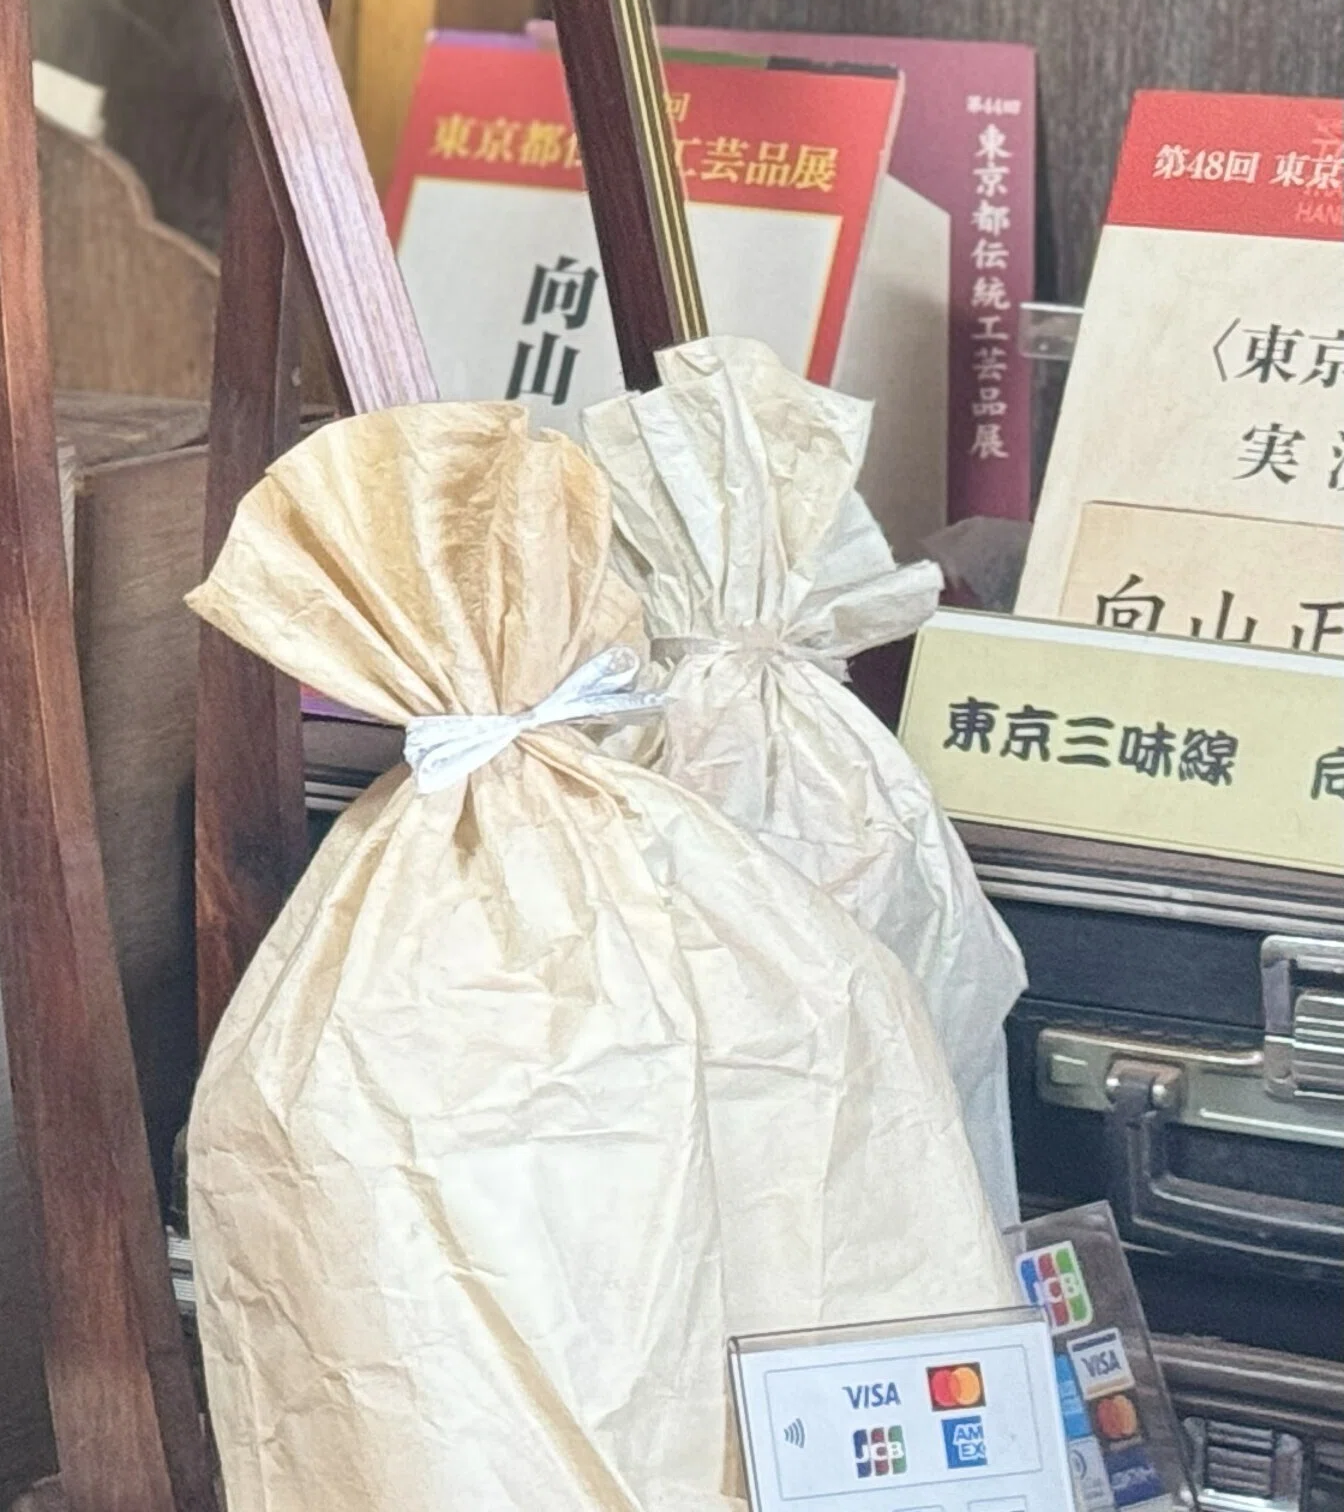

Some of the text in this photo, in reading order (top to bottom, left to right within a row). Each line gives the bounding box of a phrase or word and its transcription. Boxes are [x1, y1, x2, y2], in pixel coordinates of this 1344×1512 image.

[1153, 144, 1261, 184] 第48回
[971, 123, 1012, 460] 東京都伝統工芸品展
[505, 255, 599, 405] 向山
[942, 696, 1239, 786] 東京三味線
[1081, 1350, 1122, 1377] VISA
[842, 1382, 901, 1410] VISA
[856, 1441, 904, 1464] JCB
